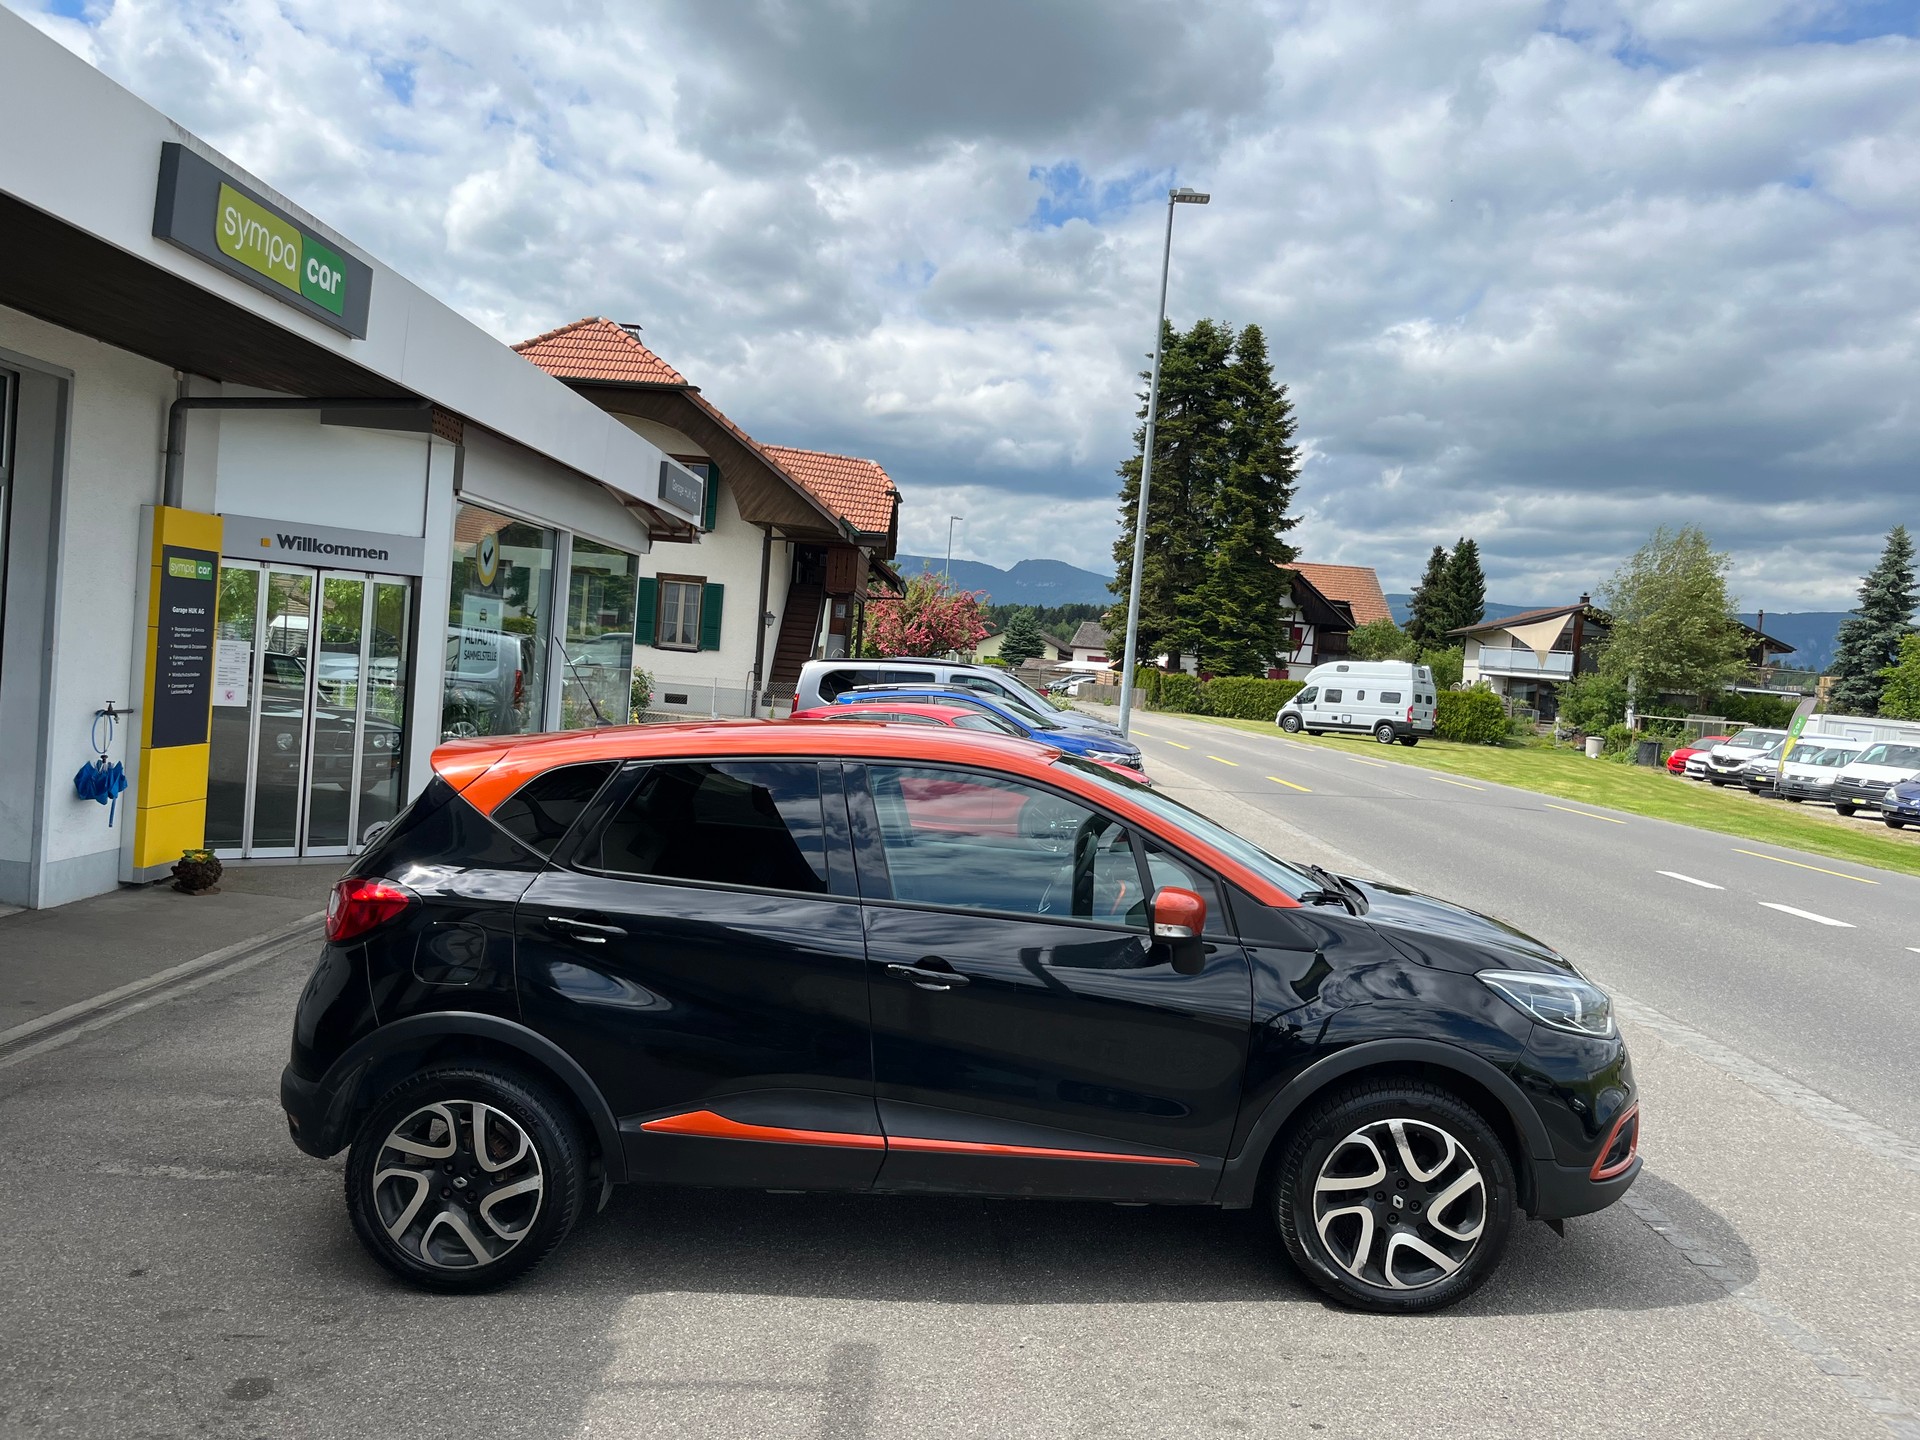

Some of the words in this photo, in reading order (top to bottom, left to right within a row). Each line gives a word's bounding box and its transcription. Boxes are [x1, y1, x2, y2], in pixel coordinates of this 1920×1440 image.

[224, 206, 297, 272] sympa
[306, 257, 342, 295] car
[276, 533, 389, 561] Willkommen
[170, 562, 195, 575] sympa
[198, 566, 211, 575] car
[172, 606, 188, 615] Garage
[465, 628, 498, 646] ALTAUTO
[463, 650, 498, 662] SAMMELSTELLE
